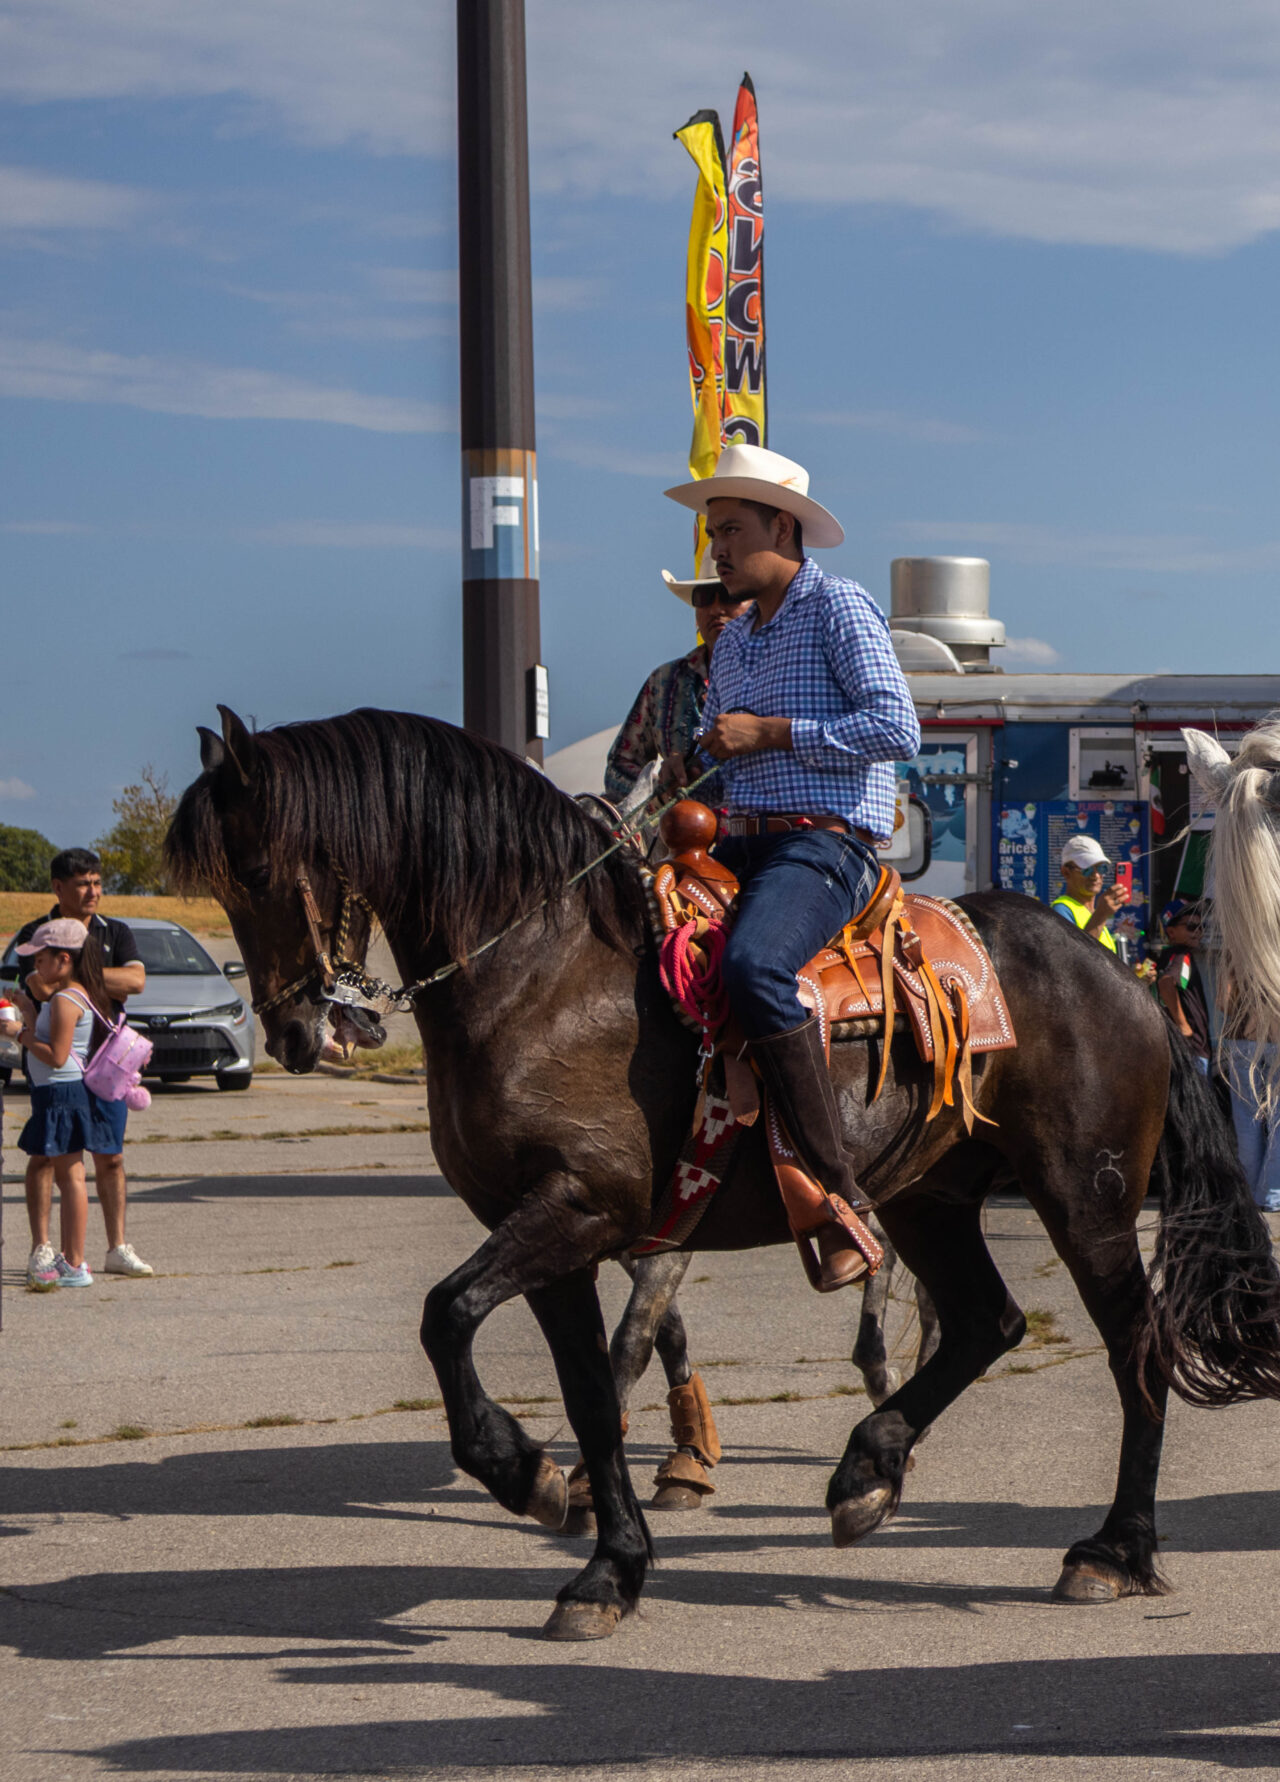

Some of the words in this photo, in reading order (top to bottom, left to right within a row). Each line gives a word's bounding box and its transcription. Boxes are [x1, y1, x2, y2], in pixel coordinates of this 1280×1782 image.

[470, 477, 524, 549] F
[999, 842, 1038, 855] Prices
[1000, 856, 1014, 865] SM
